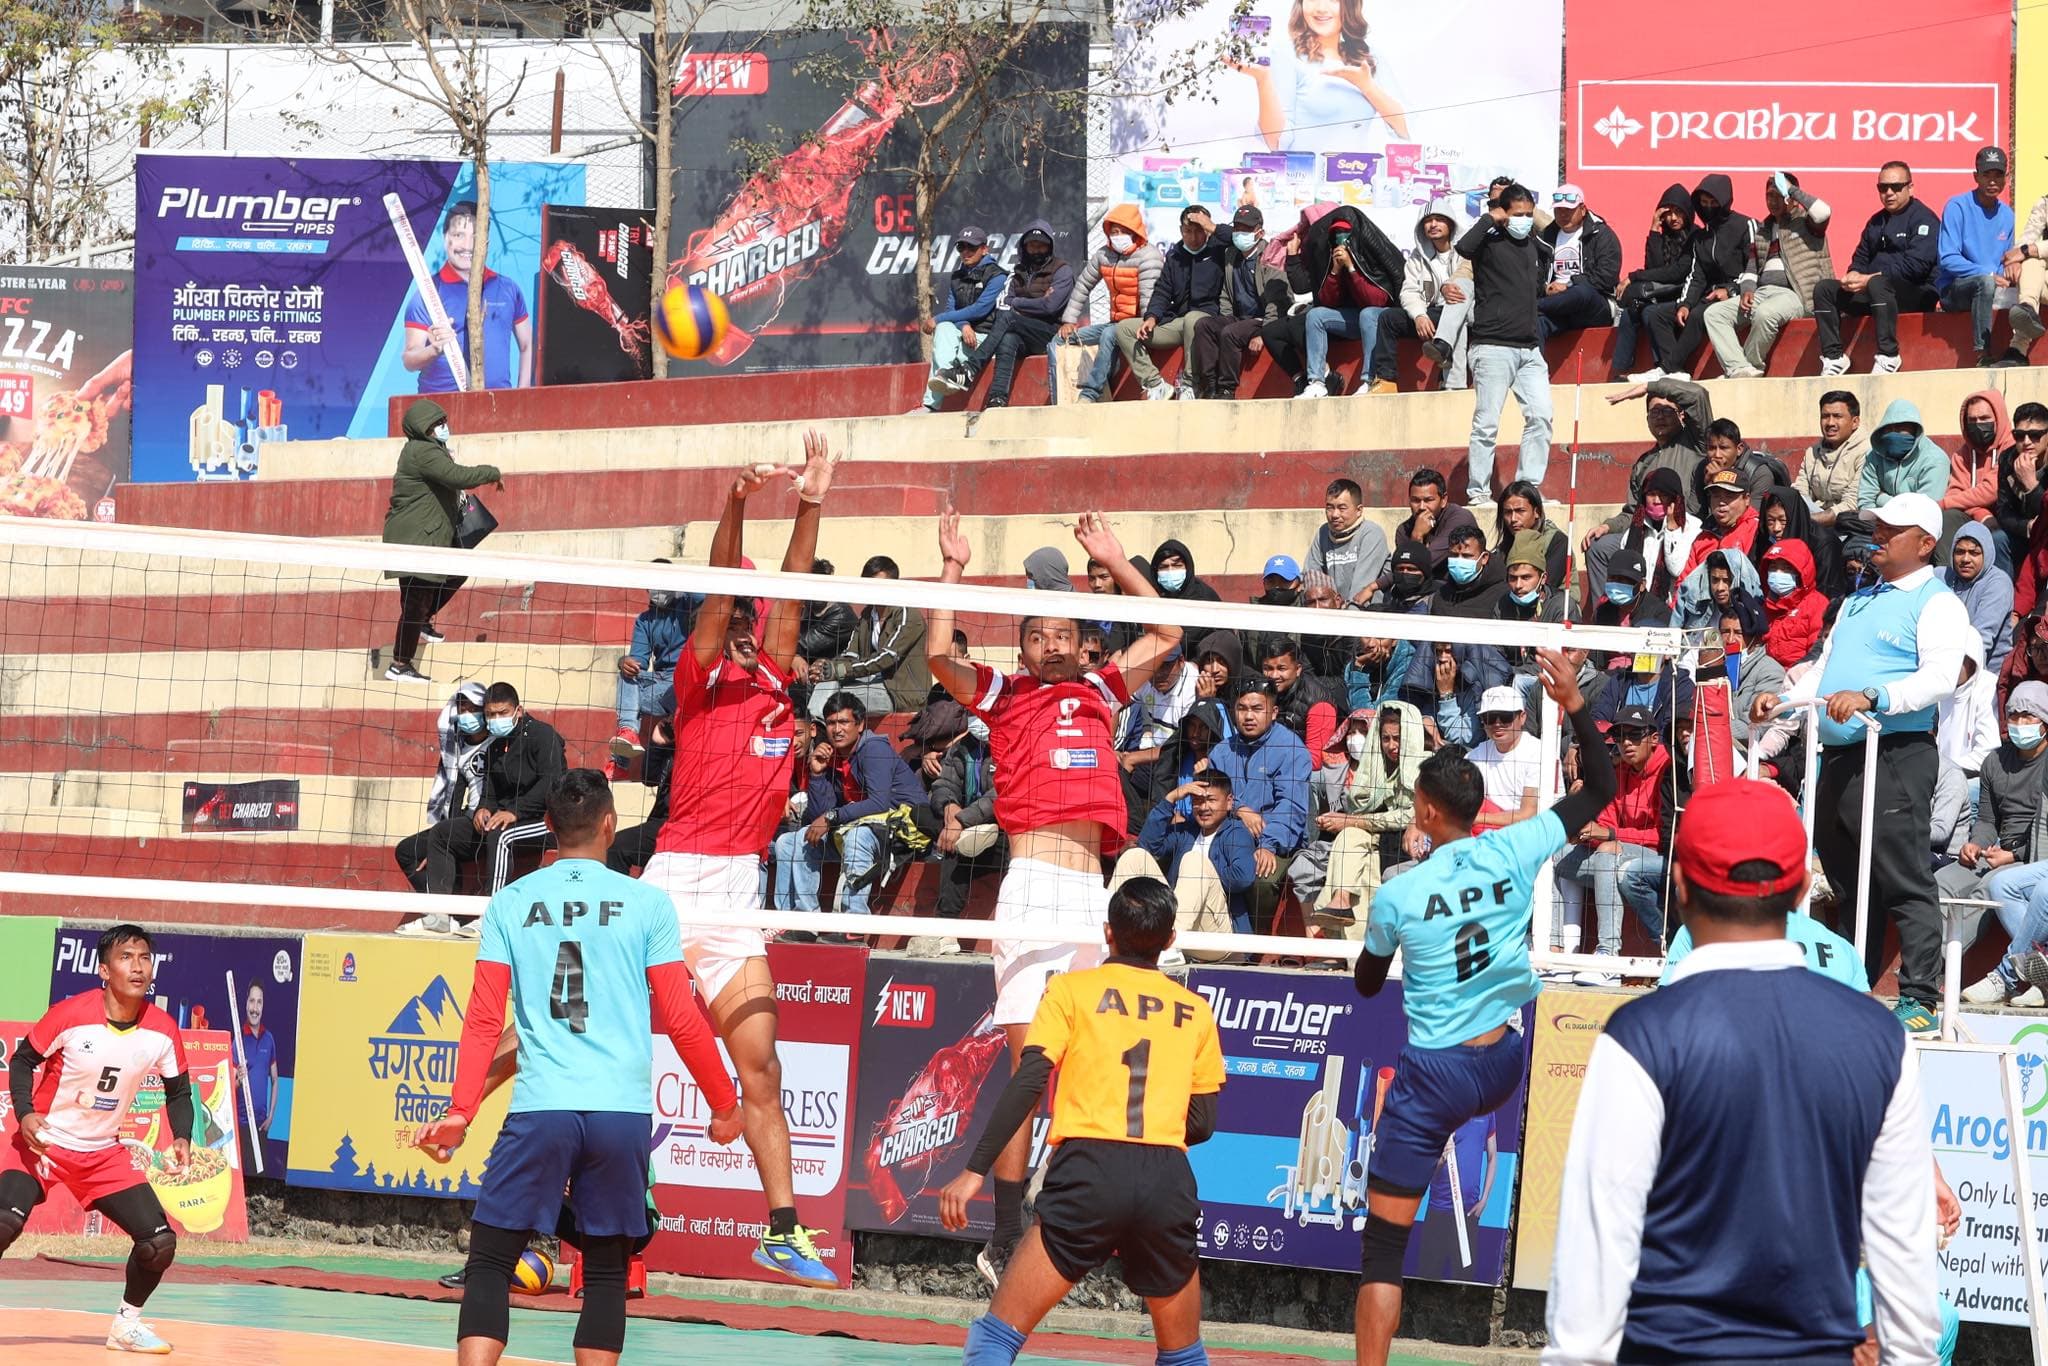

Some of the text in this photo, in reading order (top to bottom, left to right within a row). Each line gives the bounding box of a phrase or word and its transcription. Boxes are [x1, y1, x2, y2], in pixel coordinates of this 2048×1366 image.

[696, 60, 751, 89] NEW
[1337, 158, 1368, 170] Softy
[875, 194, 917, 233] GE
[294, 223, 335, 235] PIPES
[630, 226, 640, 245] TRY
[617, 222, 630, 280] CHARGED
[1555, 261, 1580, 270] FILA
[37, 278, 67, 290] YEAR
[173, 280, 220, 307] आँखा
[223, 284, 281, 309] चिम्लेर
[173, 309, 322, 323] PLUMBER PIPES & FITTINGS
[288, 331, 322, 344] रहन्छ
[15, 362, 30, 370] NO
[19, 380, 28, 389] AT
[232, 802, 272, 818] CHARGED
[1455, 921, 1491, 983] 6
[550, 941, 589, 1034] 4
[814, 986, 852, 1005] माध्यम
[892, 991, 926, 1021] NEW
[1293, 1039, 1327, 1054] PIPES
[368, 1037, 460, 1083] सगरमा
[97, 1066, 121, 1092] 5
[1121, 1038, 1150, 1138] 1
[656, 1072, 699, 1120] CIT
[879, 1110, 960, 1168] CHARGED
[670, 1143, 696, 1166] सिटी
[700, 1147, 744, 1172] एक्सप्रेस
[179, 1197, 206, 1208] RARA
[1958, 1181, 1998, 1209] Only
[737, 1220, 769, 1240] एक्सप्रे
[1937, 1251, 1986, 1278] Nepal
[1992, 1255, 2025, 1277] with
